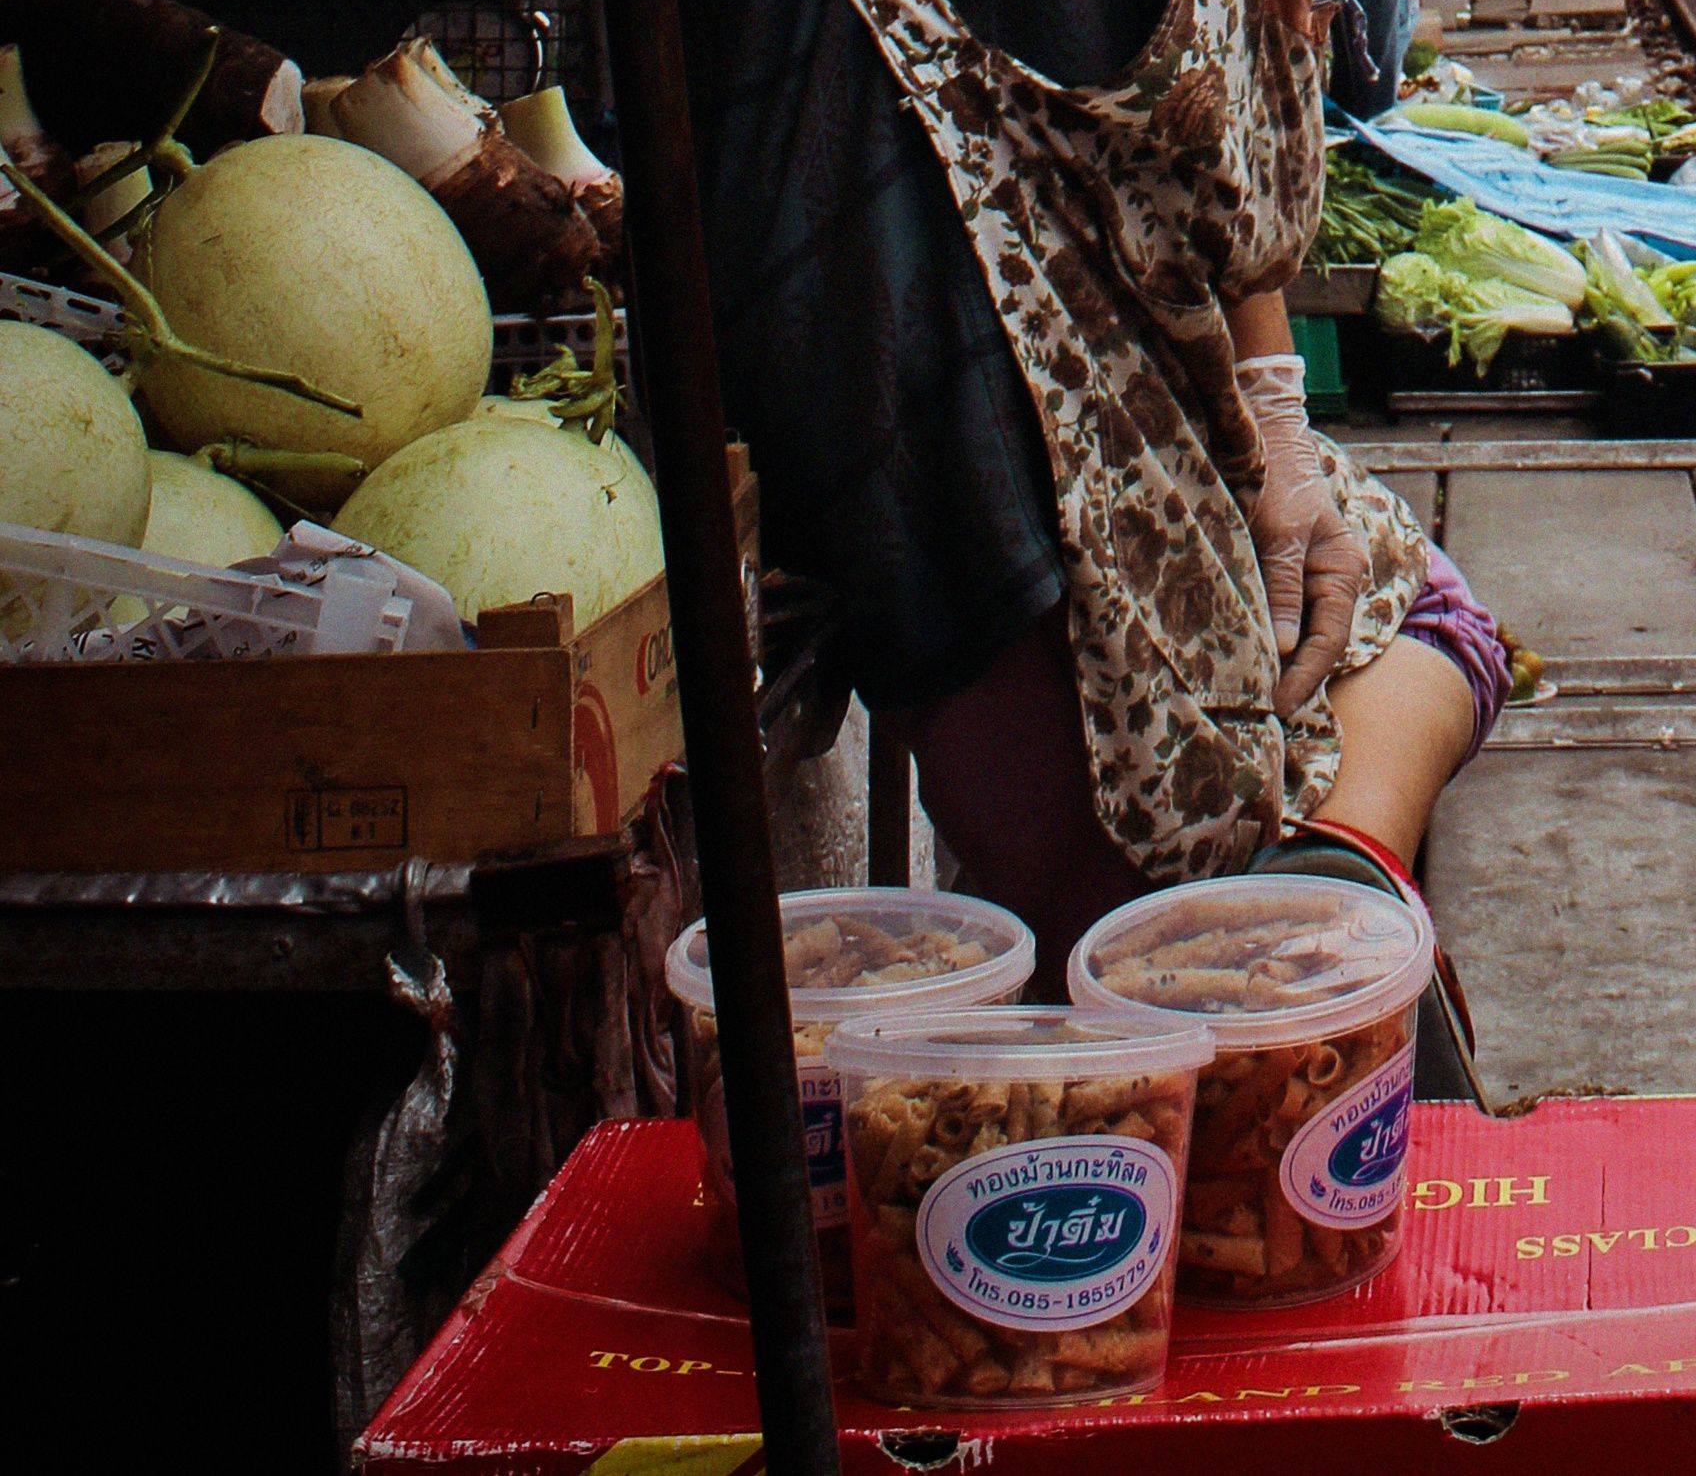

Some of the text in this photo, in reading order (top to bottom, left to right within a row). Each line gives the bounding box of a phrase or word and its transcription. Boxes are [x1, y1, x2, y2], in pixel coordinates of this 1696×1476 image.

[966, 1149, 1148, 1199] ทองม้วนกะทิสด
[1404, 1175, 1552, 1210] HIG
[590, 1350, 757, 1377] TOP-
[1396, 1369, 1570, 1393] RED
